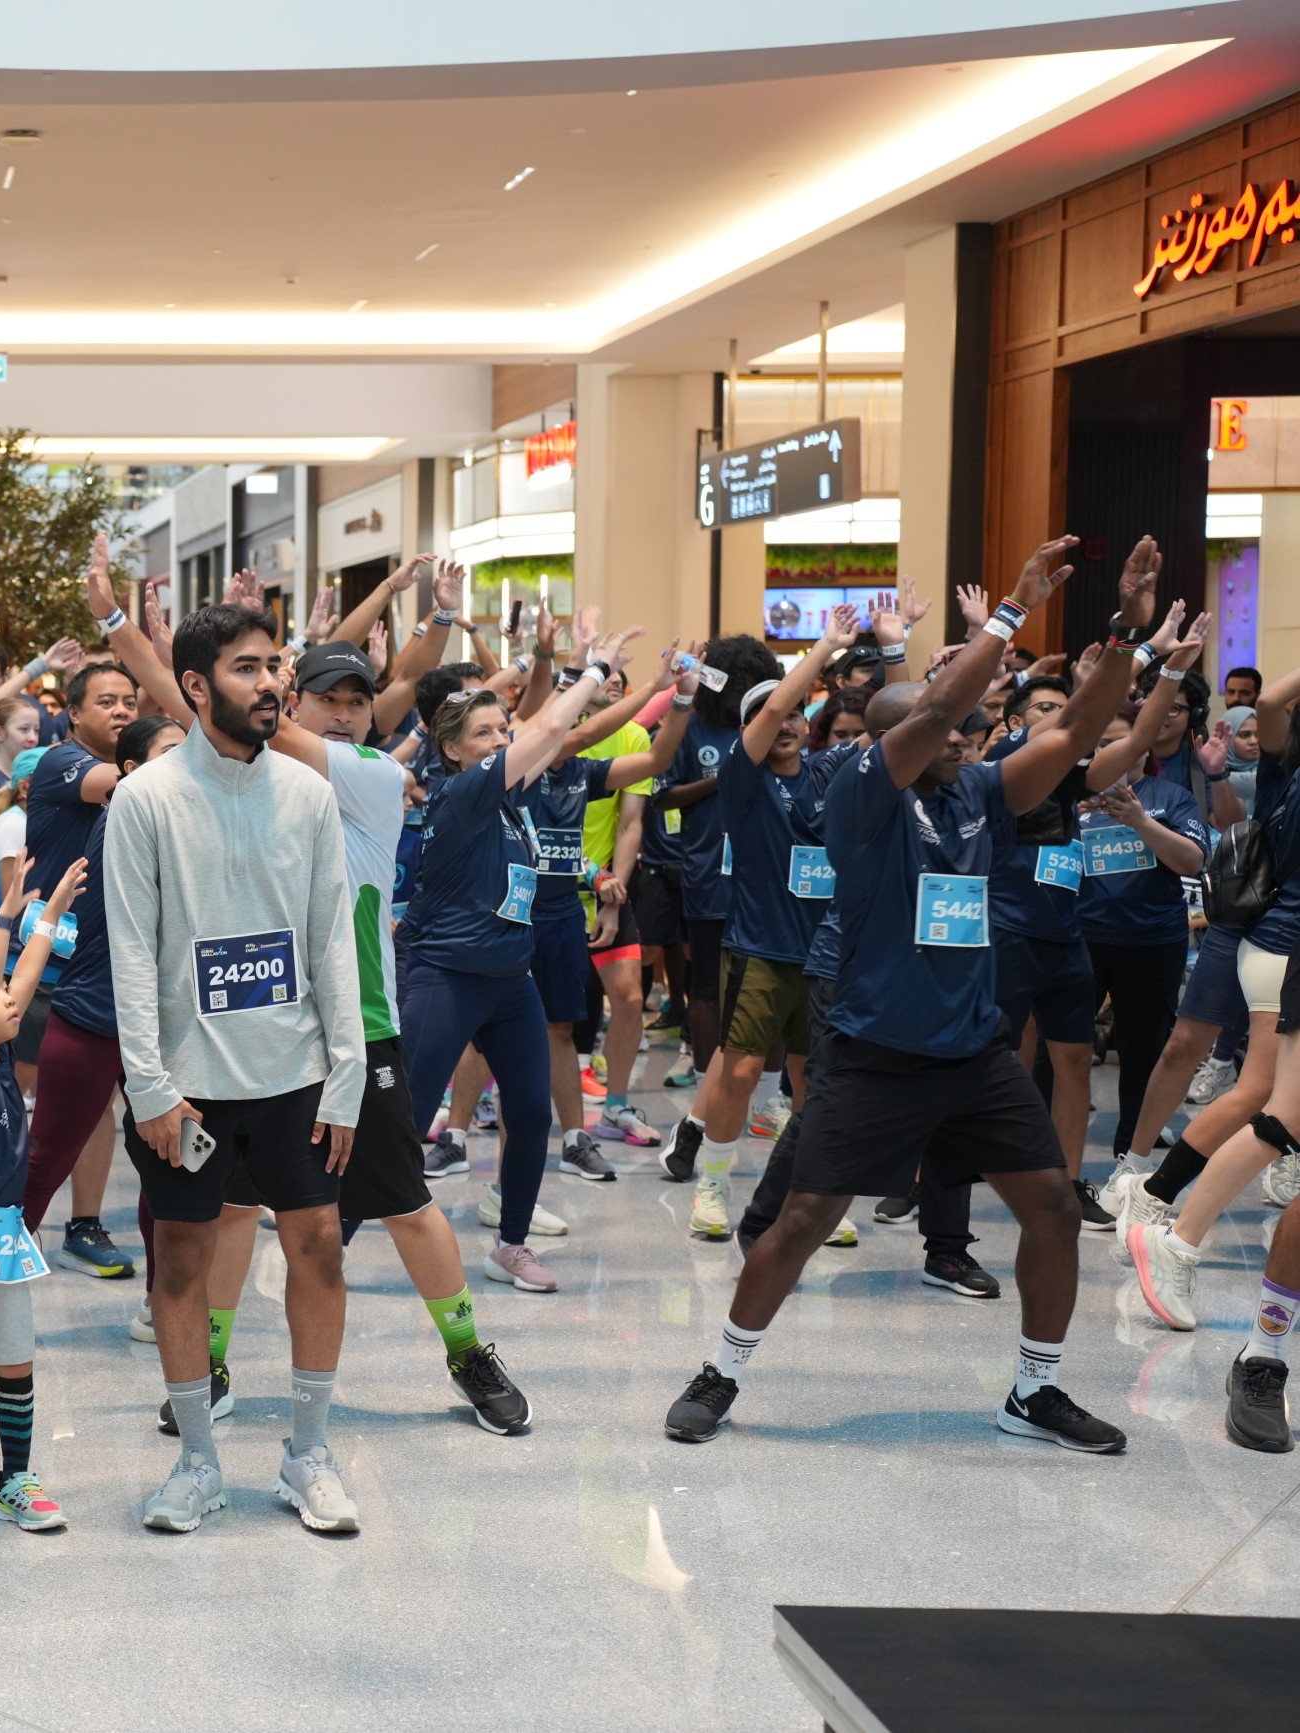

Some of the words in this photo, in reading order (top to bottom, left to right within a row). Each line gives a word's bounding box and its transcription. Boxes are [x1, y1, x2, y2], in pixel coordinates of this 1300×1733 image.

[1134, 183, 1256, 297] هورتنز
[1215, 400, 1248, 451] E
[700, 484, 714, 526] G
[541, 845, 581, 860] 22320
[1091, 840, 1145, 858] 54439
[208, 957, 285, 986] 24200
[1020, 1356, 1052, 1371] LEAVE
[1024, 1365, 1038, 1374] ME
[1020, 1369, 1050, 1380] ALONE
